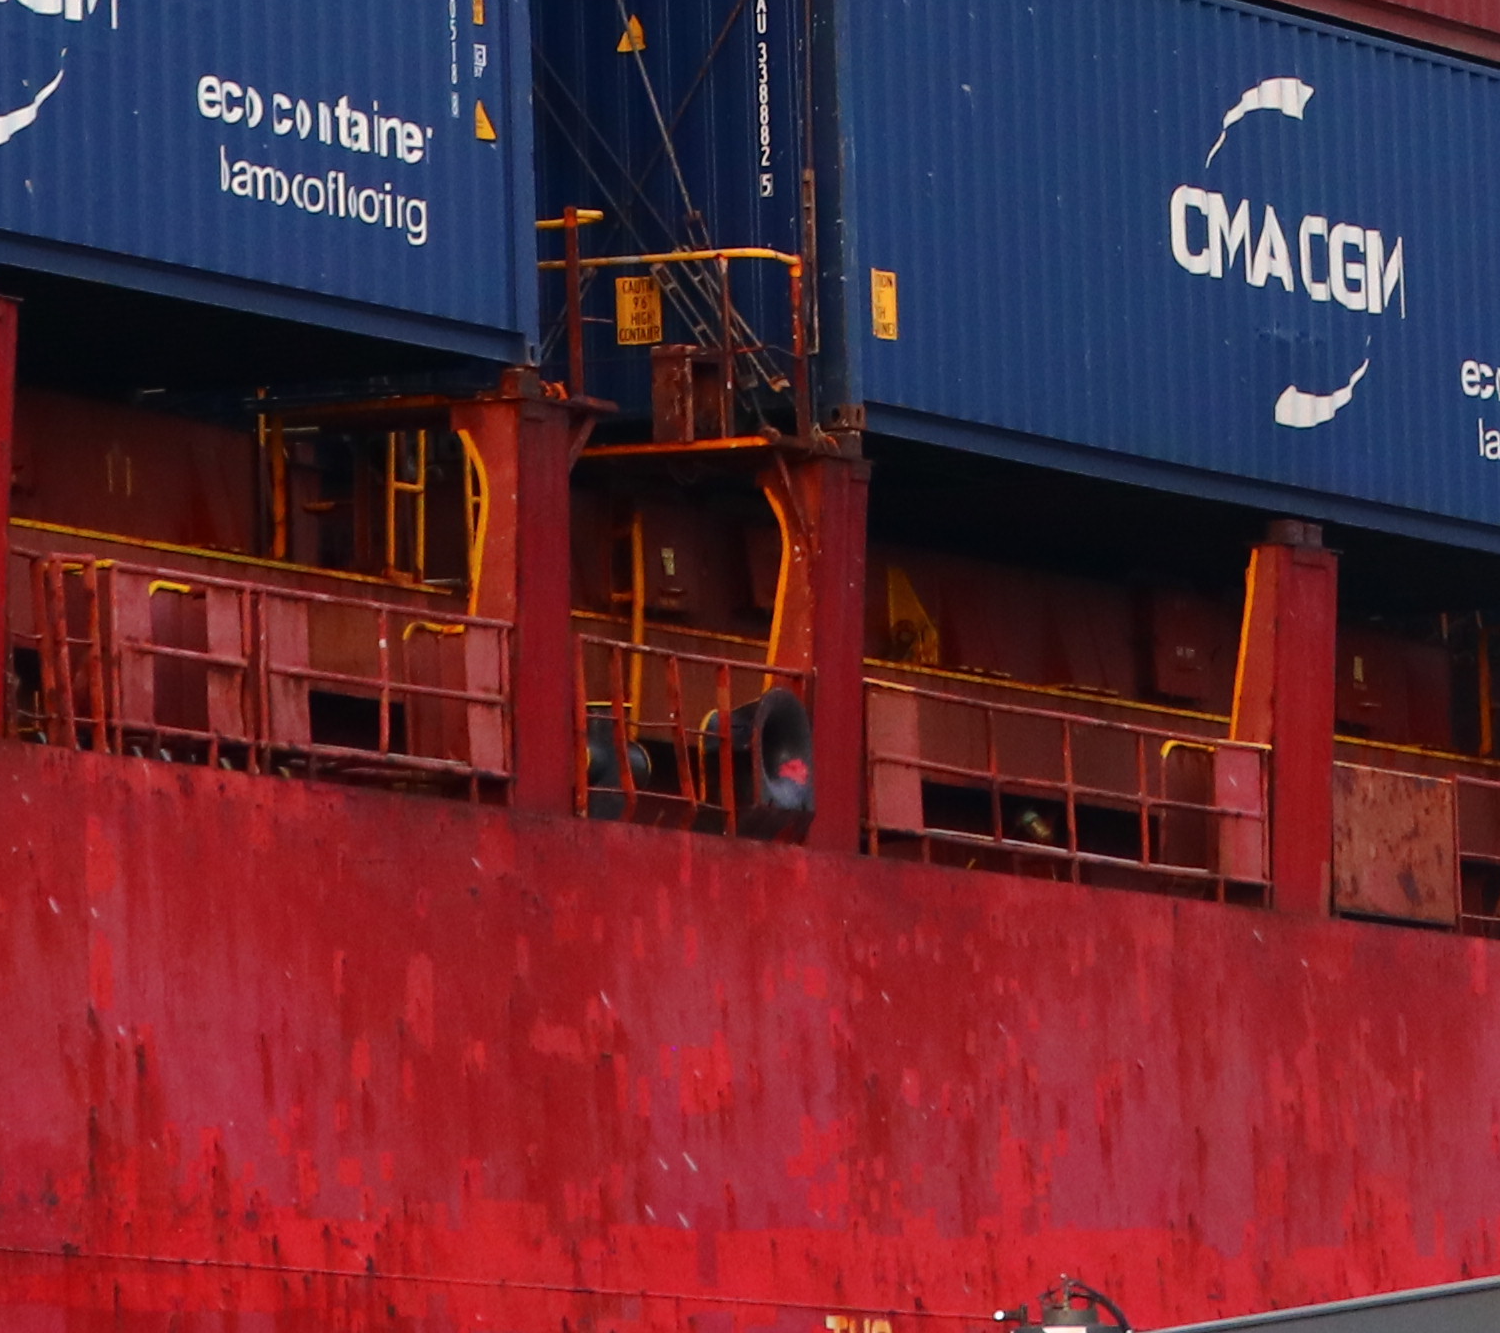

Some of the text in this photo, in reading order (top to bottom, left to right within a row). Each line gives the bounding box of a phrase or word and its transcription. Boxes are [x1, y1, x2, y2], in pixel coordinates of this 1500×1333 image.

[197, 74, 264, 129] eco
[756, 42, 771, 169] 338882
[327, 170, 428, 247] flooing
[759, 173, 773, 198] 5
[1169, 184, 1407, 319] CMA CGM
